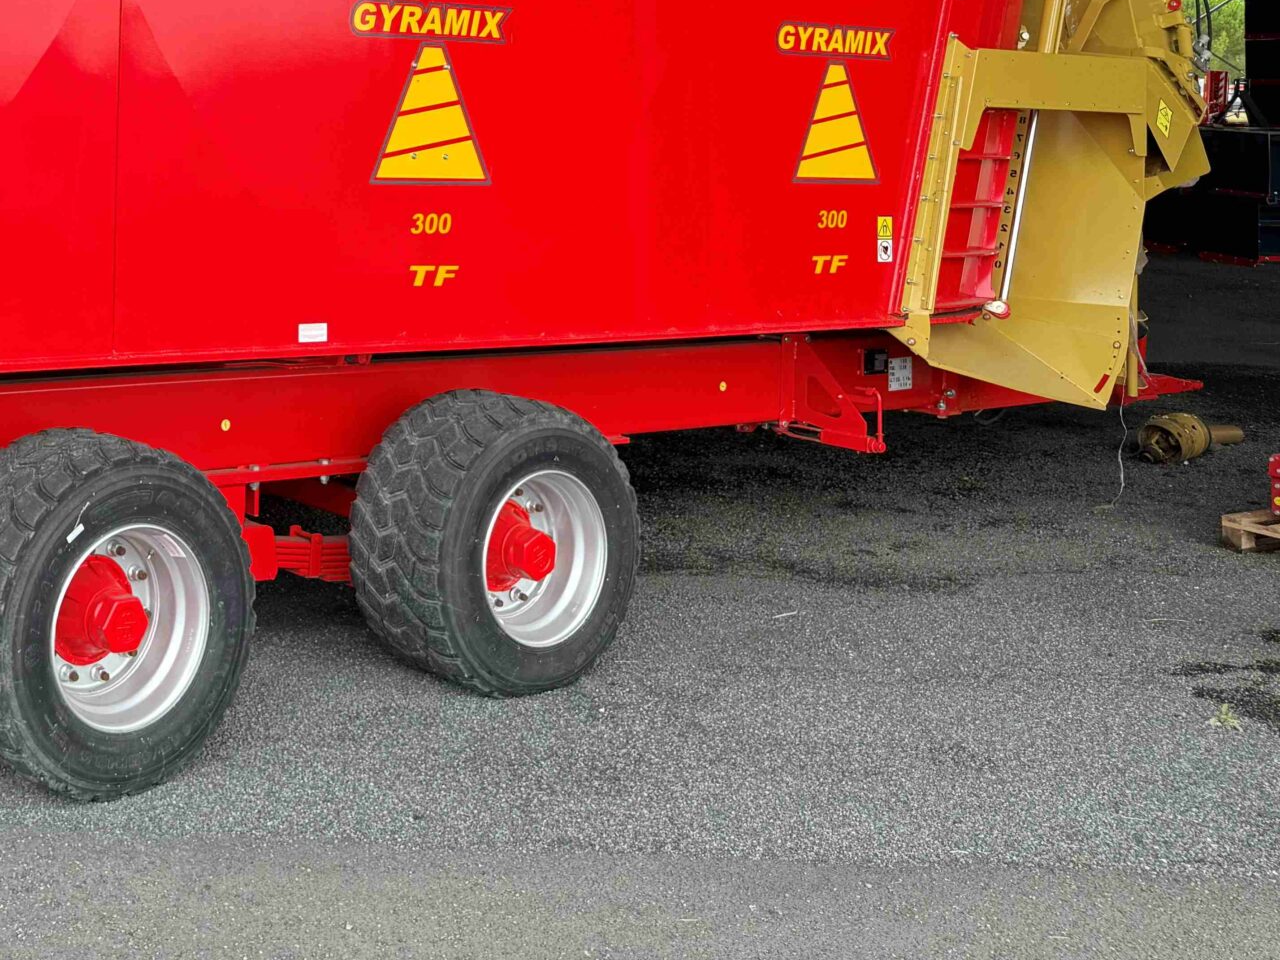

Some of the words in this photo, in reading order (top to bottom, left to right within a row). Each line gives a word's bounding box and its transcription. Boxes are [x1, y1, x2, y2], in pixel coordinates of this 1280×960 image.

[352, 1, 505, 39] GYRAMIX
[777, 24, 891, 56] GYRAMIX
[410, 212, 453, 235] 300
[817, 209, 848, 229] 300
[409, 264, 460, 287] TF
[811, 254, 849, 275] TF
